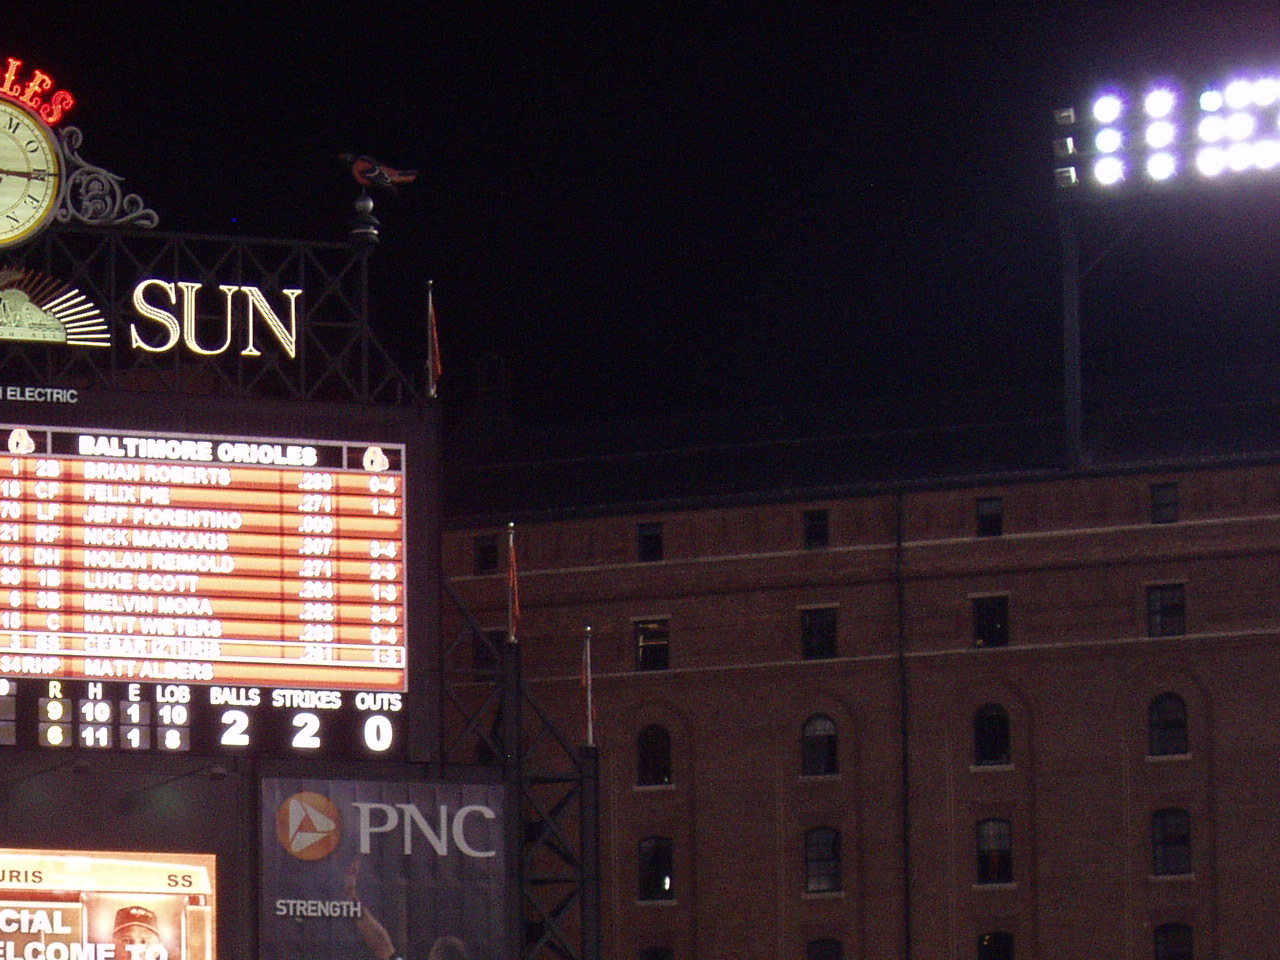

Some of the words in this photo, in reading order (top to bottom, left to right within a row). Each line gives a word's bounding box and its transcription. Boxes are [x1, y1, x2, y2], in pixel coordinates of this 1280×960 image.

[130, 278, 303, 358] SUN
[6, 385, 79, 404] ELECTRIC
[79, 435, 213, 461] BALTIMORE
[217, 442, 317, 466] ORIOLES
[10, 458, 19, 475] 1
[36, 459, 60, 477] 2B
[84, 461, 140, 481] BRIAN
[144, 463, 231, 485] ROBERTS
[369, 475, 396, 493] 0-4
[34, 481, 60, 499] CF
[84, 483, 136, 503] FELIX
[140, 486, 170, 505] PIE
[298, 494, 332, 512] .271
[370, 497, 396, 515] 1-4
[0, 501, 21, 519] 70
[36, 503, 60, 521] LF
[83, 505, 128, 524] JEFF
[133, 507, 242, 529] FIORENTINO
[298, 515, 333, 533] .000
[0, 523, 19, 541] 21
[35, 525, 60, 543] RF
[84, 527, 129, 546] NICK
[132, 530, 228, 551] MARKAKIS
[0, 546, 22, 563] 14
[34, 547, 60, 565] DH
[84, 550, 147, 569] NOLAN
[151, 552, 234, 574] REIMOLD
[298, 559, 332, 577] .271
[370, 563, 397, 580] 2-3
[84, 570, 133, 590] LUKE
[137, 573, 199, 592] SCOTT
[84, 593, 154, 613] MELVIN
[158, 596, 214, 615] MORA
[46, 613, 60, 631] C
[84, 615, 136, 634] MATT
[140, 617, 222, 637] WIETERS
[22, 656, 61, 675] RHP
[84, 659, 136, 678] MATT
[139, 660, 215, 681] ALBERS
[49, 680, 63, 699] R
[88, 682, 102, 700] H
[129, 684, 141, 702] E
[156, 685, 190, 703] LOB
[210, 687, 261, 706] BALLS
[272, 689, 342, 709] STRIKES
[355, 692, 403, 712] OUTS
[47, 700, 63, 721] 9
[81, 702, 110, 722] 10
[127, 704, 140, 723] 1
[159, 705, 187, 725] 10
[221, 710, 249, 746] 2
[47, 725, 63, 746] 6
[81, 727, 108, 747] 11
[127, 728, 140, 748] 1
[292, 713, 320, 748] 2
[364, 715, 393, 752] 0
[352, 802, 496, 857] PNC
[167, 874, 194, 888] SS
[276, 900, 362, 917] STRENGTH
